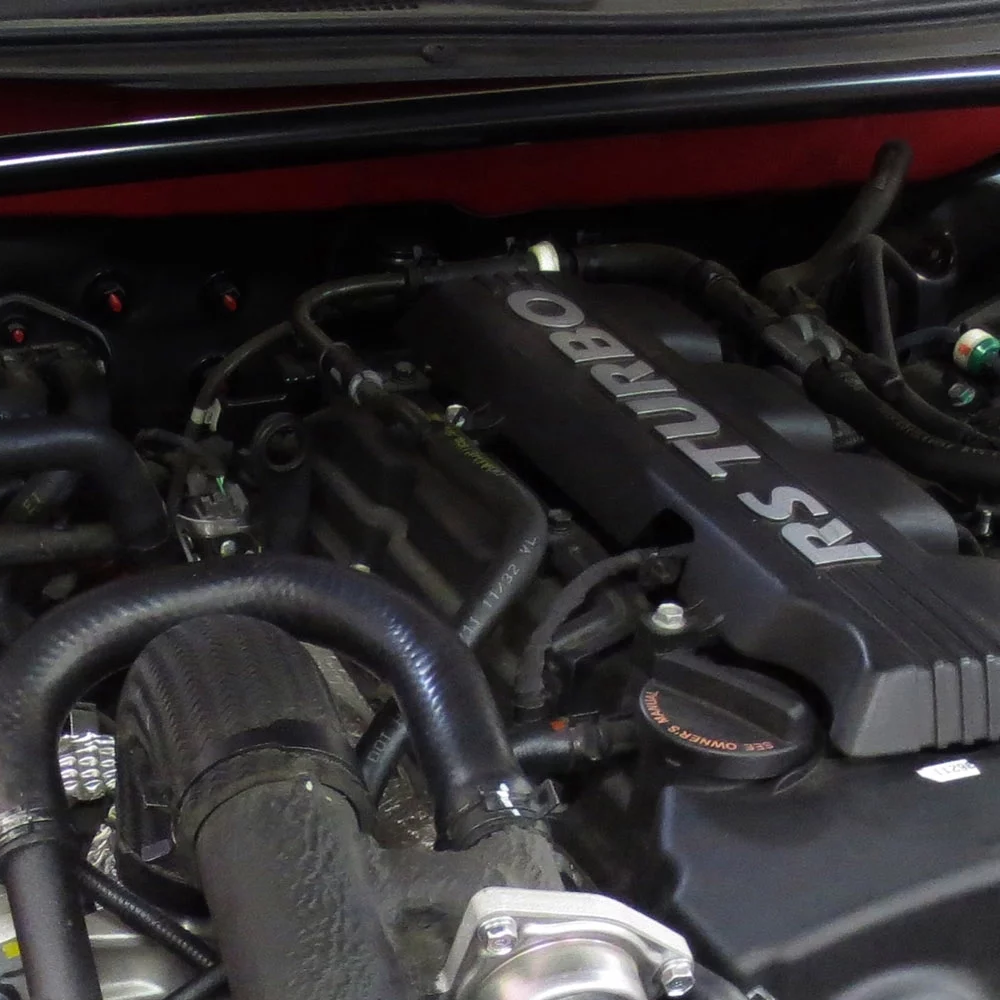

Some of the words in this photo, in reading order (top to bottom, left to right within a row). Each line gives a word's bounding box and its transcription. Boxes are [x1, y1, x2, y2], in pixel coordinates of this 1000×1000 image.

[508, 290, 761, 478] TURBO
[737, 486, 882, 565] RS
[668, 725, 738, 751] OWNER'S
[744, 741, 775, 752] SEE
